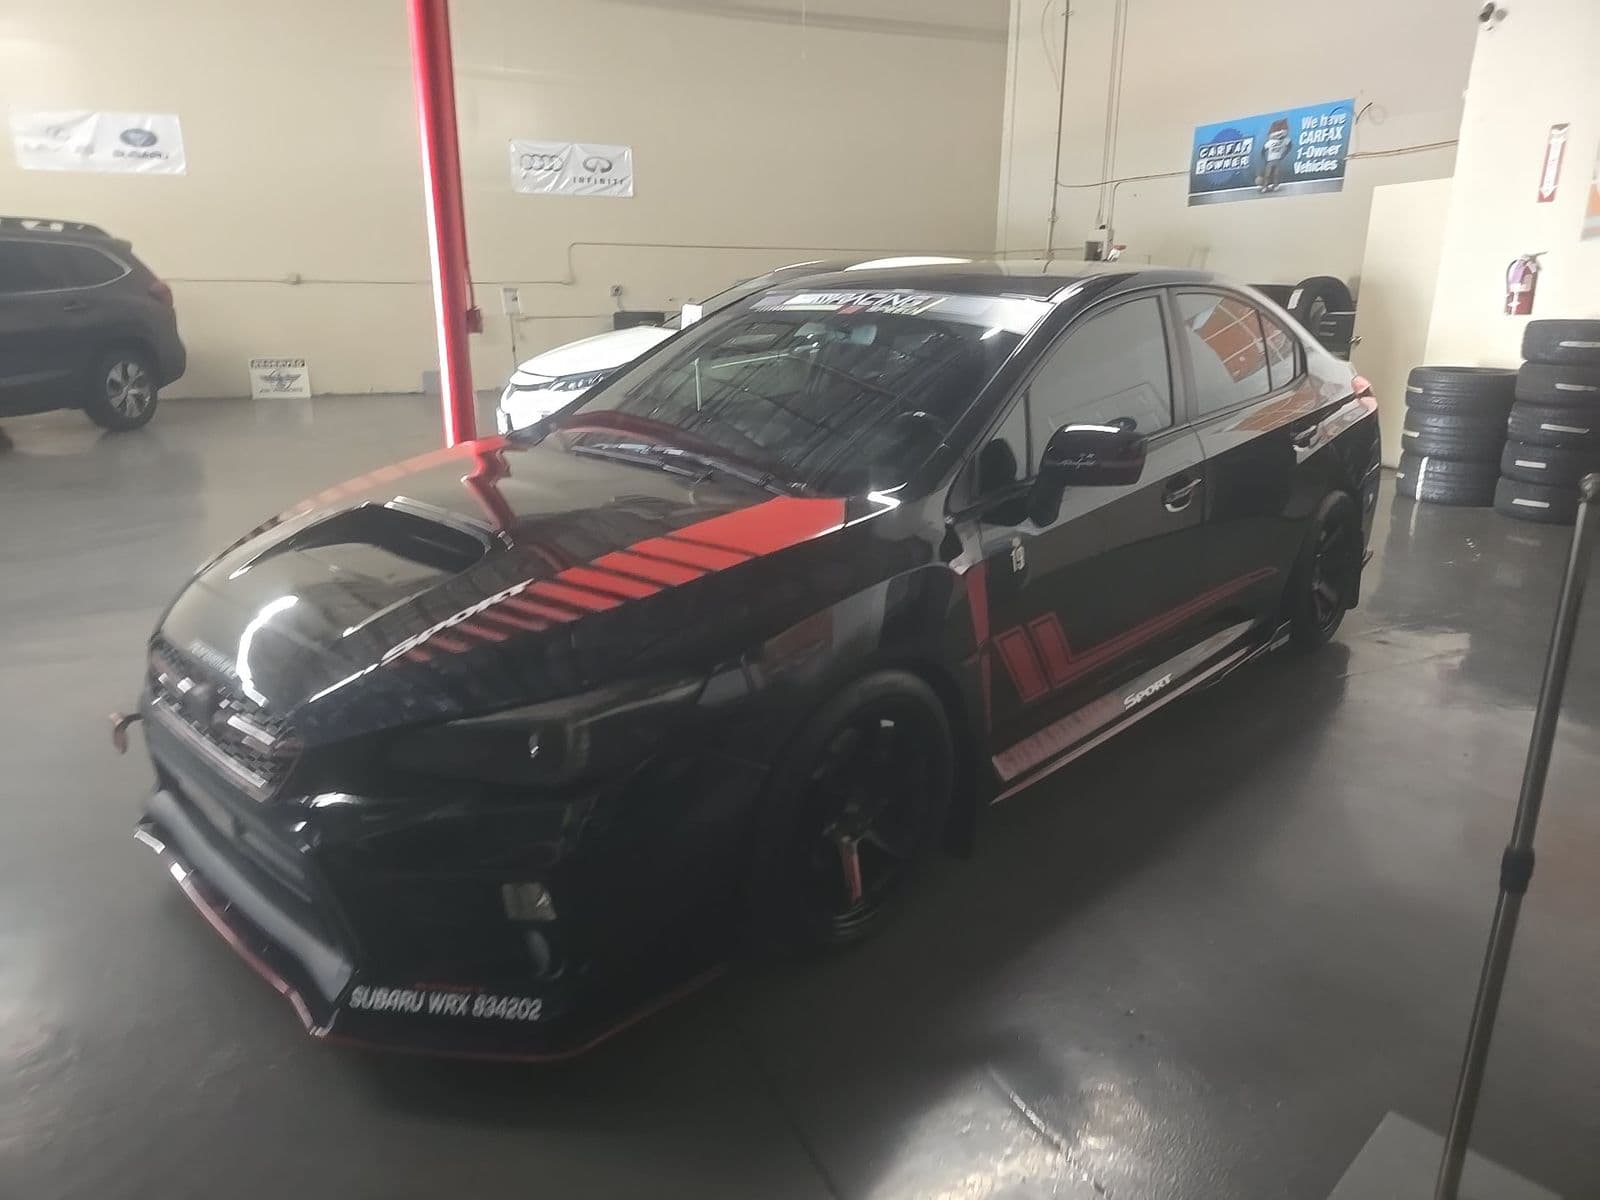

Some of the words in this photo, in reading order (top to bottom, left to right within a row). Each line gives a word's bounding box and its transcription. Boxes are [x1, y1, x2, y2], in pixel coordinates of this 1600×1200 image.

[1302, 115, 1318, 129] We
[1321, 113, 1346, 127] have
[1299, 126, 1344, 145] CARFAX
[1296, 144, 1341, 160] 1-Owner
[1294, 159, 1338, 174] Vehicles
[1123, 673, 1172, 710] SPORT
[349, 985, 425, 1012] SUBARU
[428, 992, 471, 1016] WRX
